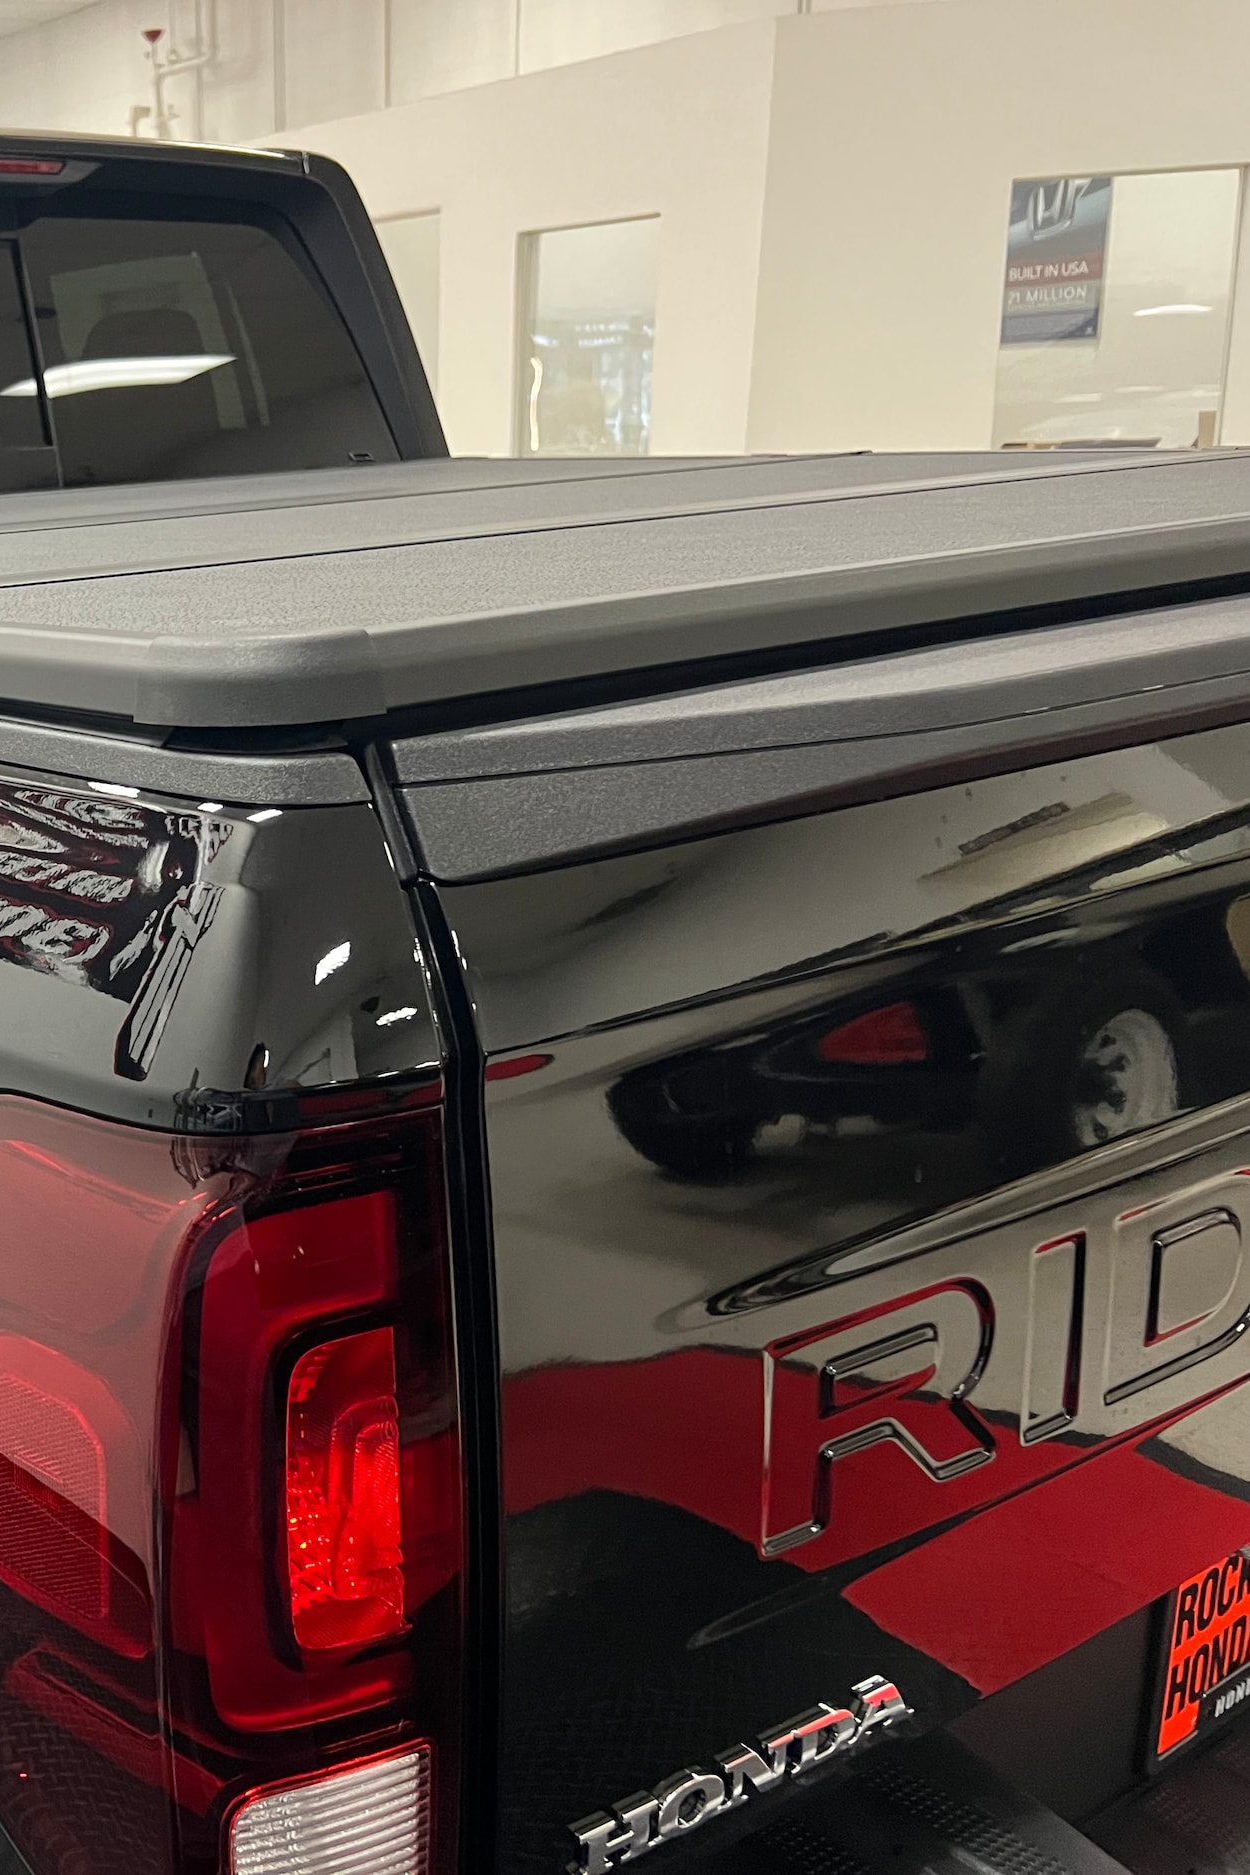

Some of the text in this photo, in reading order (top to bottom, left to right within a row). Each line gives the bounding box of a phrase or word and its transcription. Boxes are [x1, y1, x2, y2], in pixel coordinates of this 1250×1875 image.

[1008, 260, 1089, 282] BUILT IN USA
[1025, 284, 1088, 303] MILLION
[1165, 1614, 1250, 1721] HOND
[566, 1675, 915, 1875] HONDA
